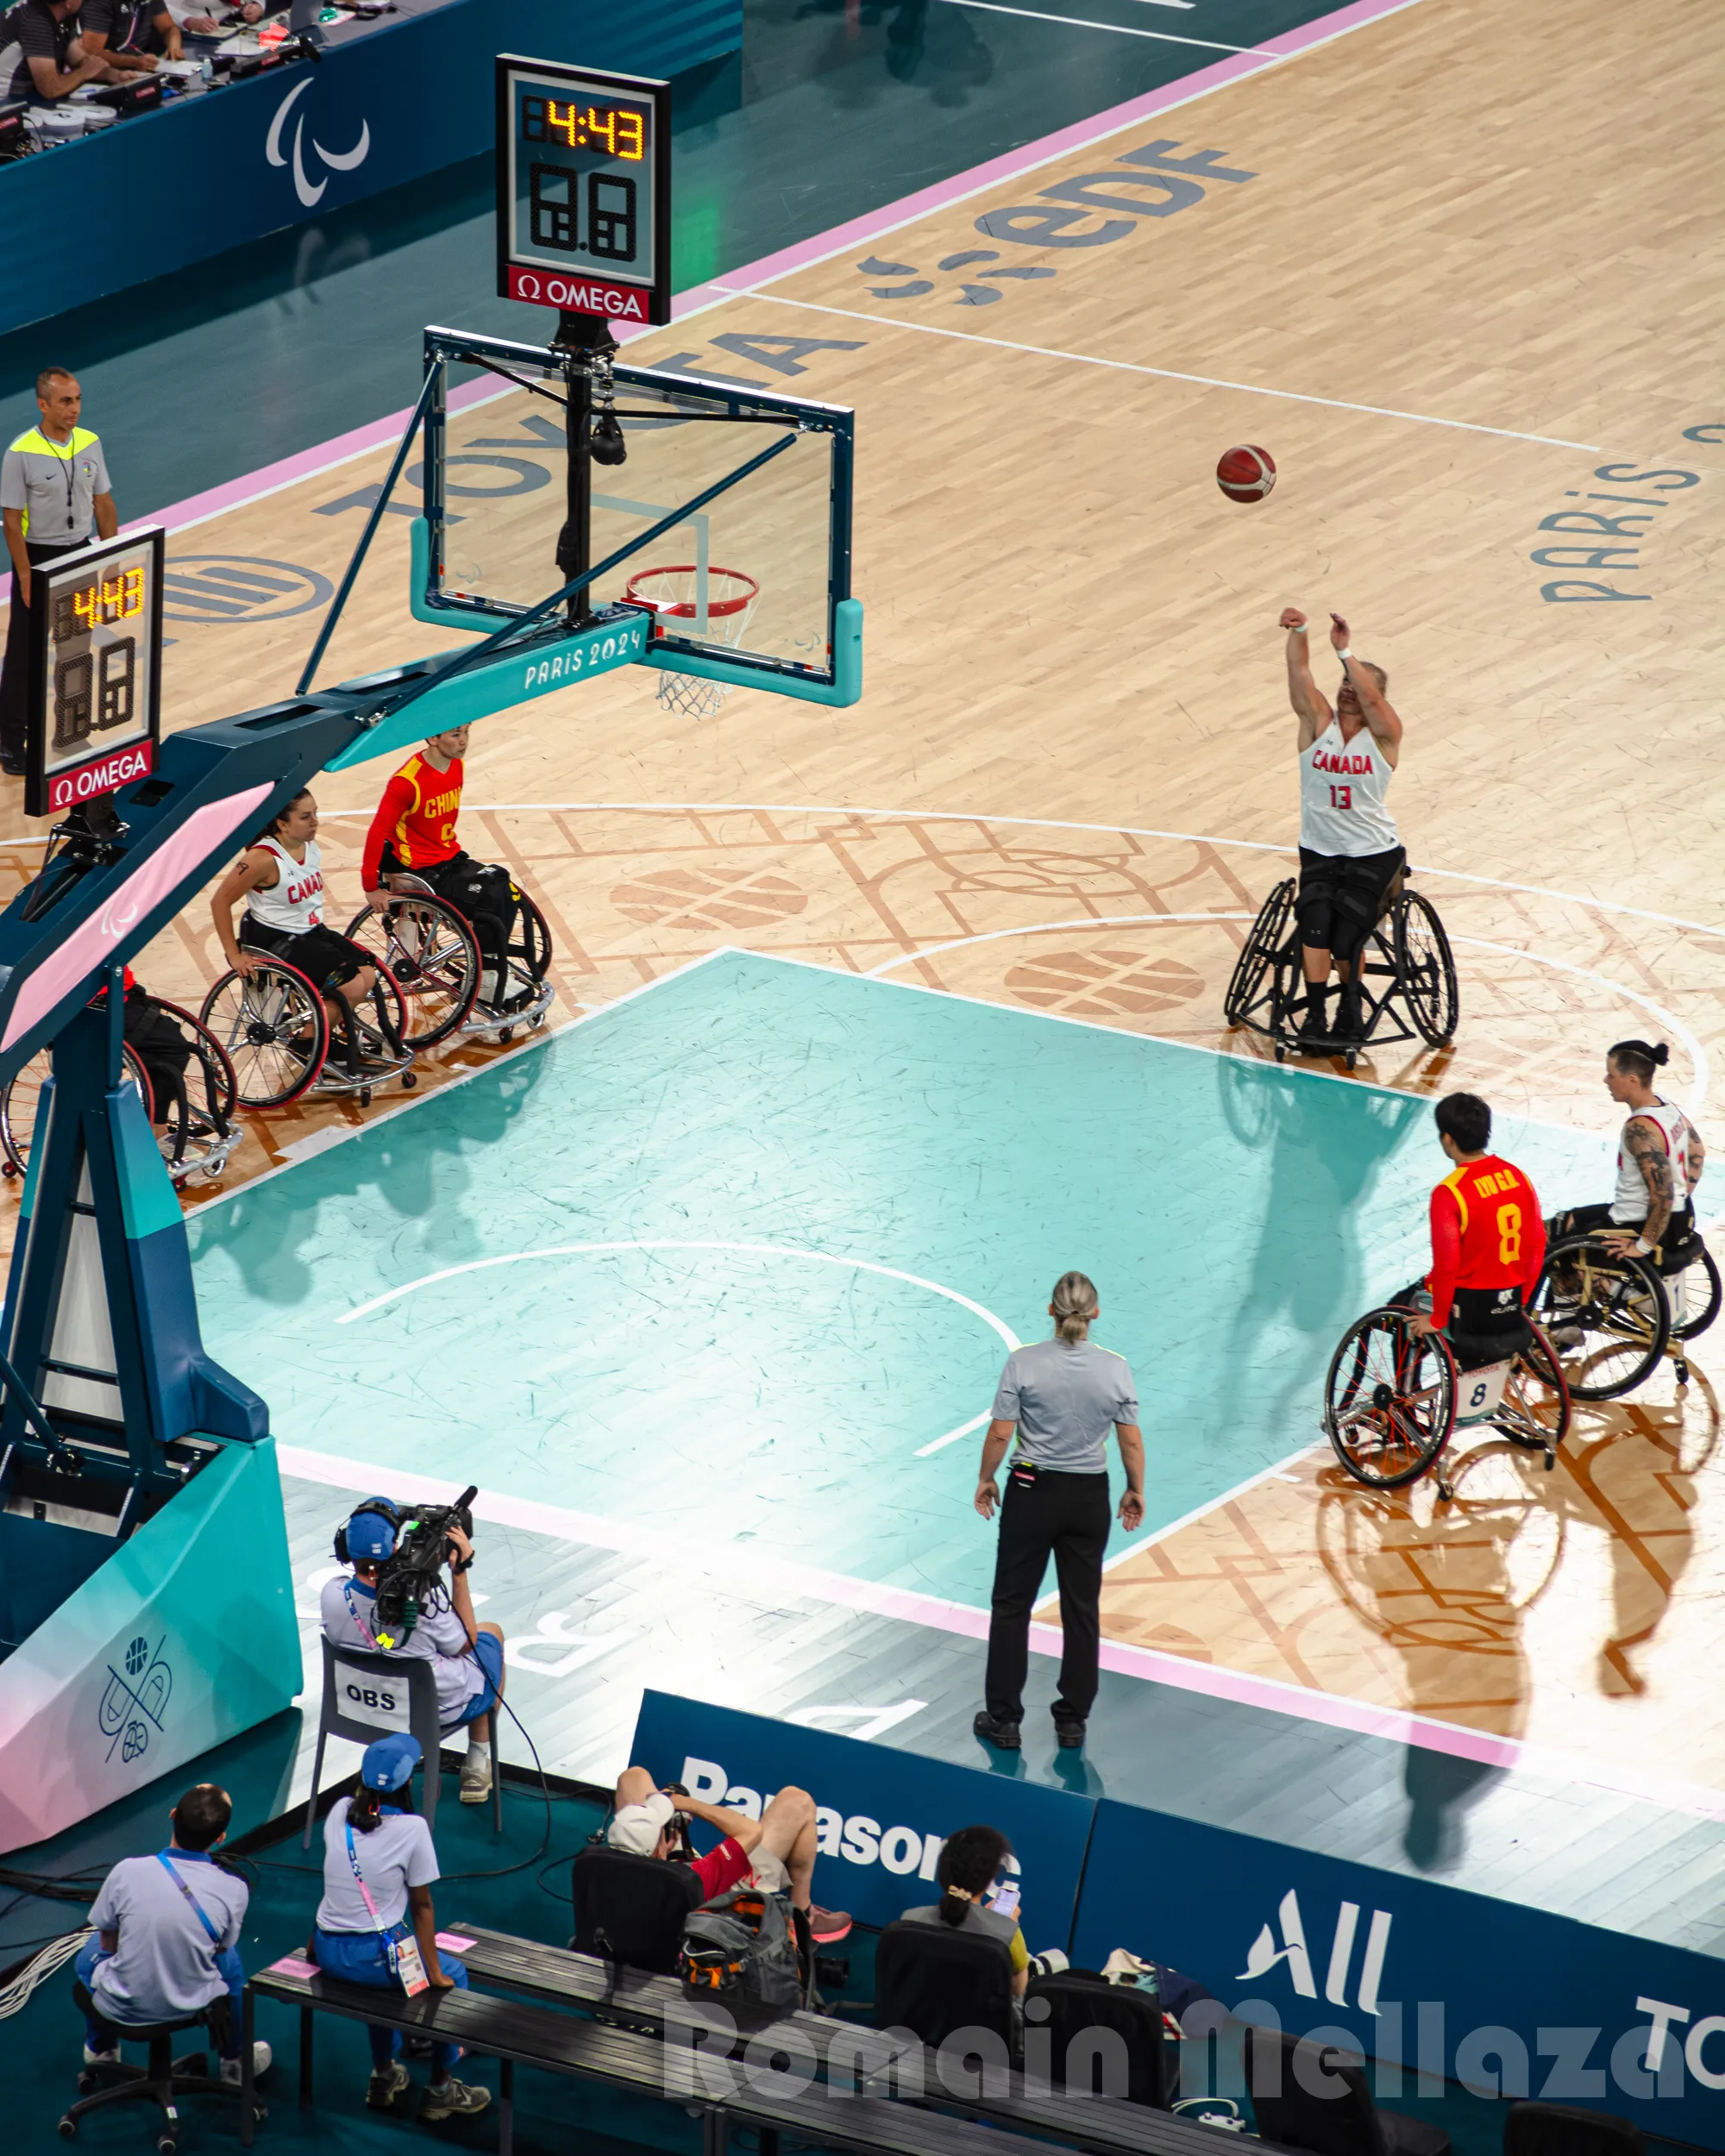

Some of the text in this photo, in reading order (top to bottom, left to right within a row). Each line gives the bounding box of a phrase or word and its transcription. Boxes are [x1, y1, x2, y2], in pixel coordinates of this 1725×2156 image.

[548, 100, 644, 161] 4:43
[547, 279, 643, 319] OMEGA
[73, 567, 145, 630] 4:43
[588, 630, 641, 667] 2024
[77, 750, 147, 797] OMEGA
[1312, 749, 1374, 775] CANADA
[424, 786, 461, 819] CHIN
[1329, 784, 1352, 810] 13
[1496, 1202, 1522, 1266] 8
[1470, 1382, 1487, 1407] 8
[346, 1683, 396, 1711] OBS
